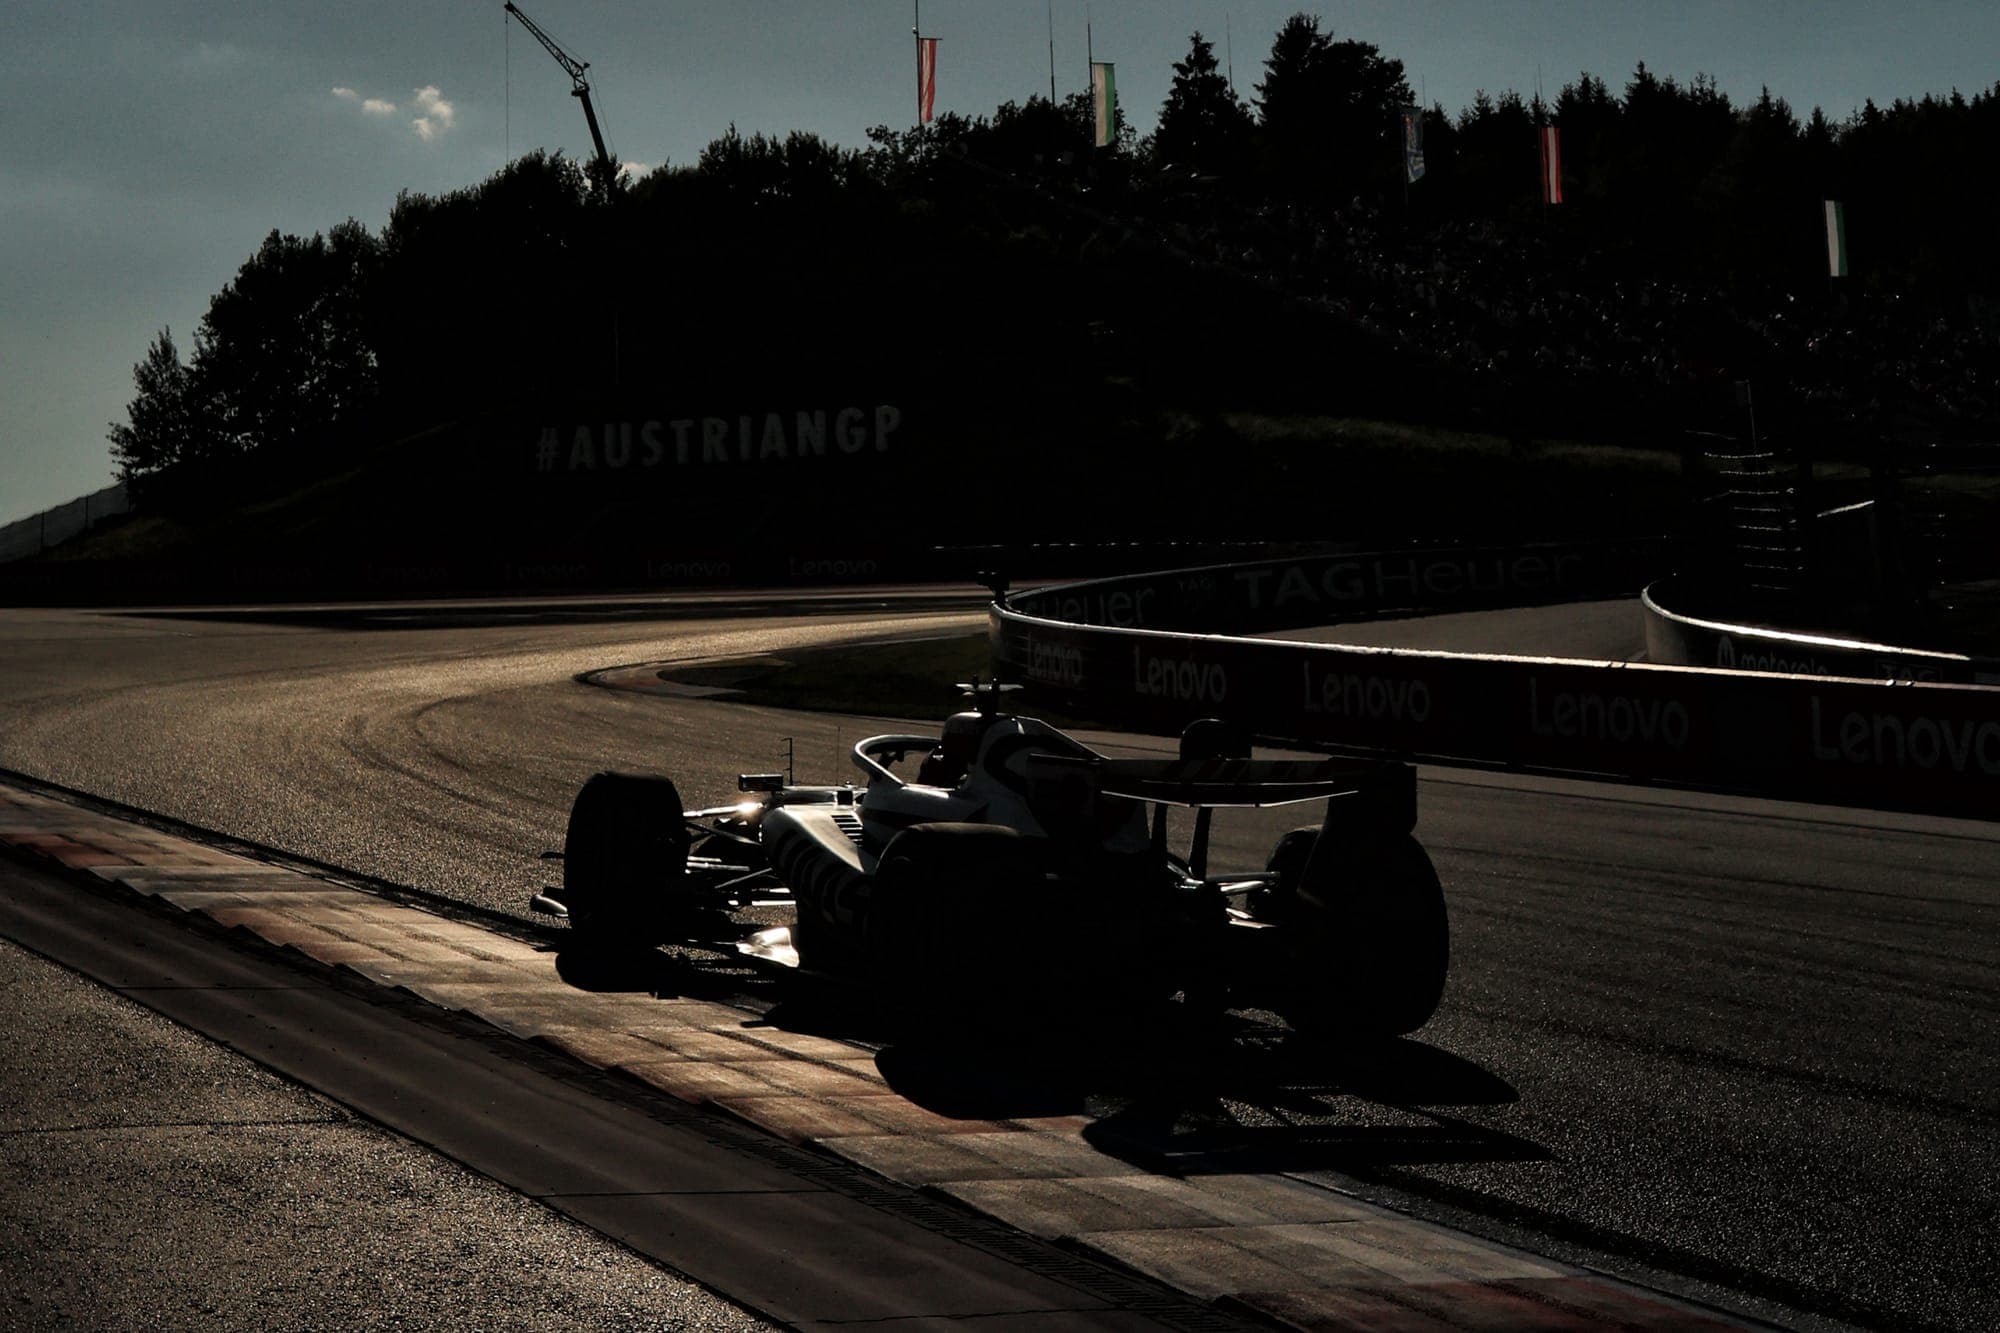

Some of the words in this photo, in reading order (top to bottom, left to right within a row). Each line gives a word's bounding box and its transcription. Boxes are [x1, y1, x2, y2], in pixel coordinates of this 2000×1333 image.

[535, 404, 902, 472] #AUSTRIANGP
[647, 557, 732, 579] Lenovo
[788, 551, 878, 578] Lenovo
[1027, 636, 1084, 687] Lenovo
[1134, 644, 1229, 701] Lenovo
[1303, 657, 1431, 723] Lenovo
[1528, 674, 1690, 751] Lenovo
[1808, 694, 2000, 778] Lenovo
